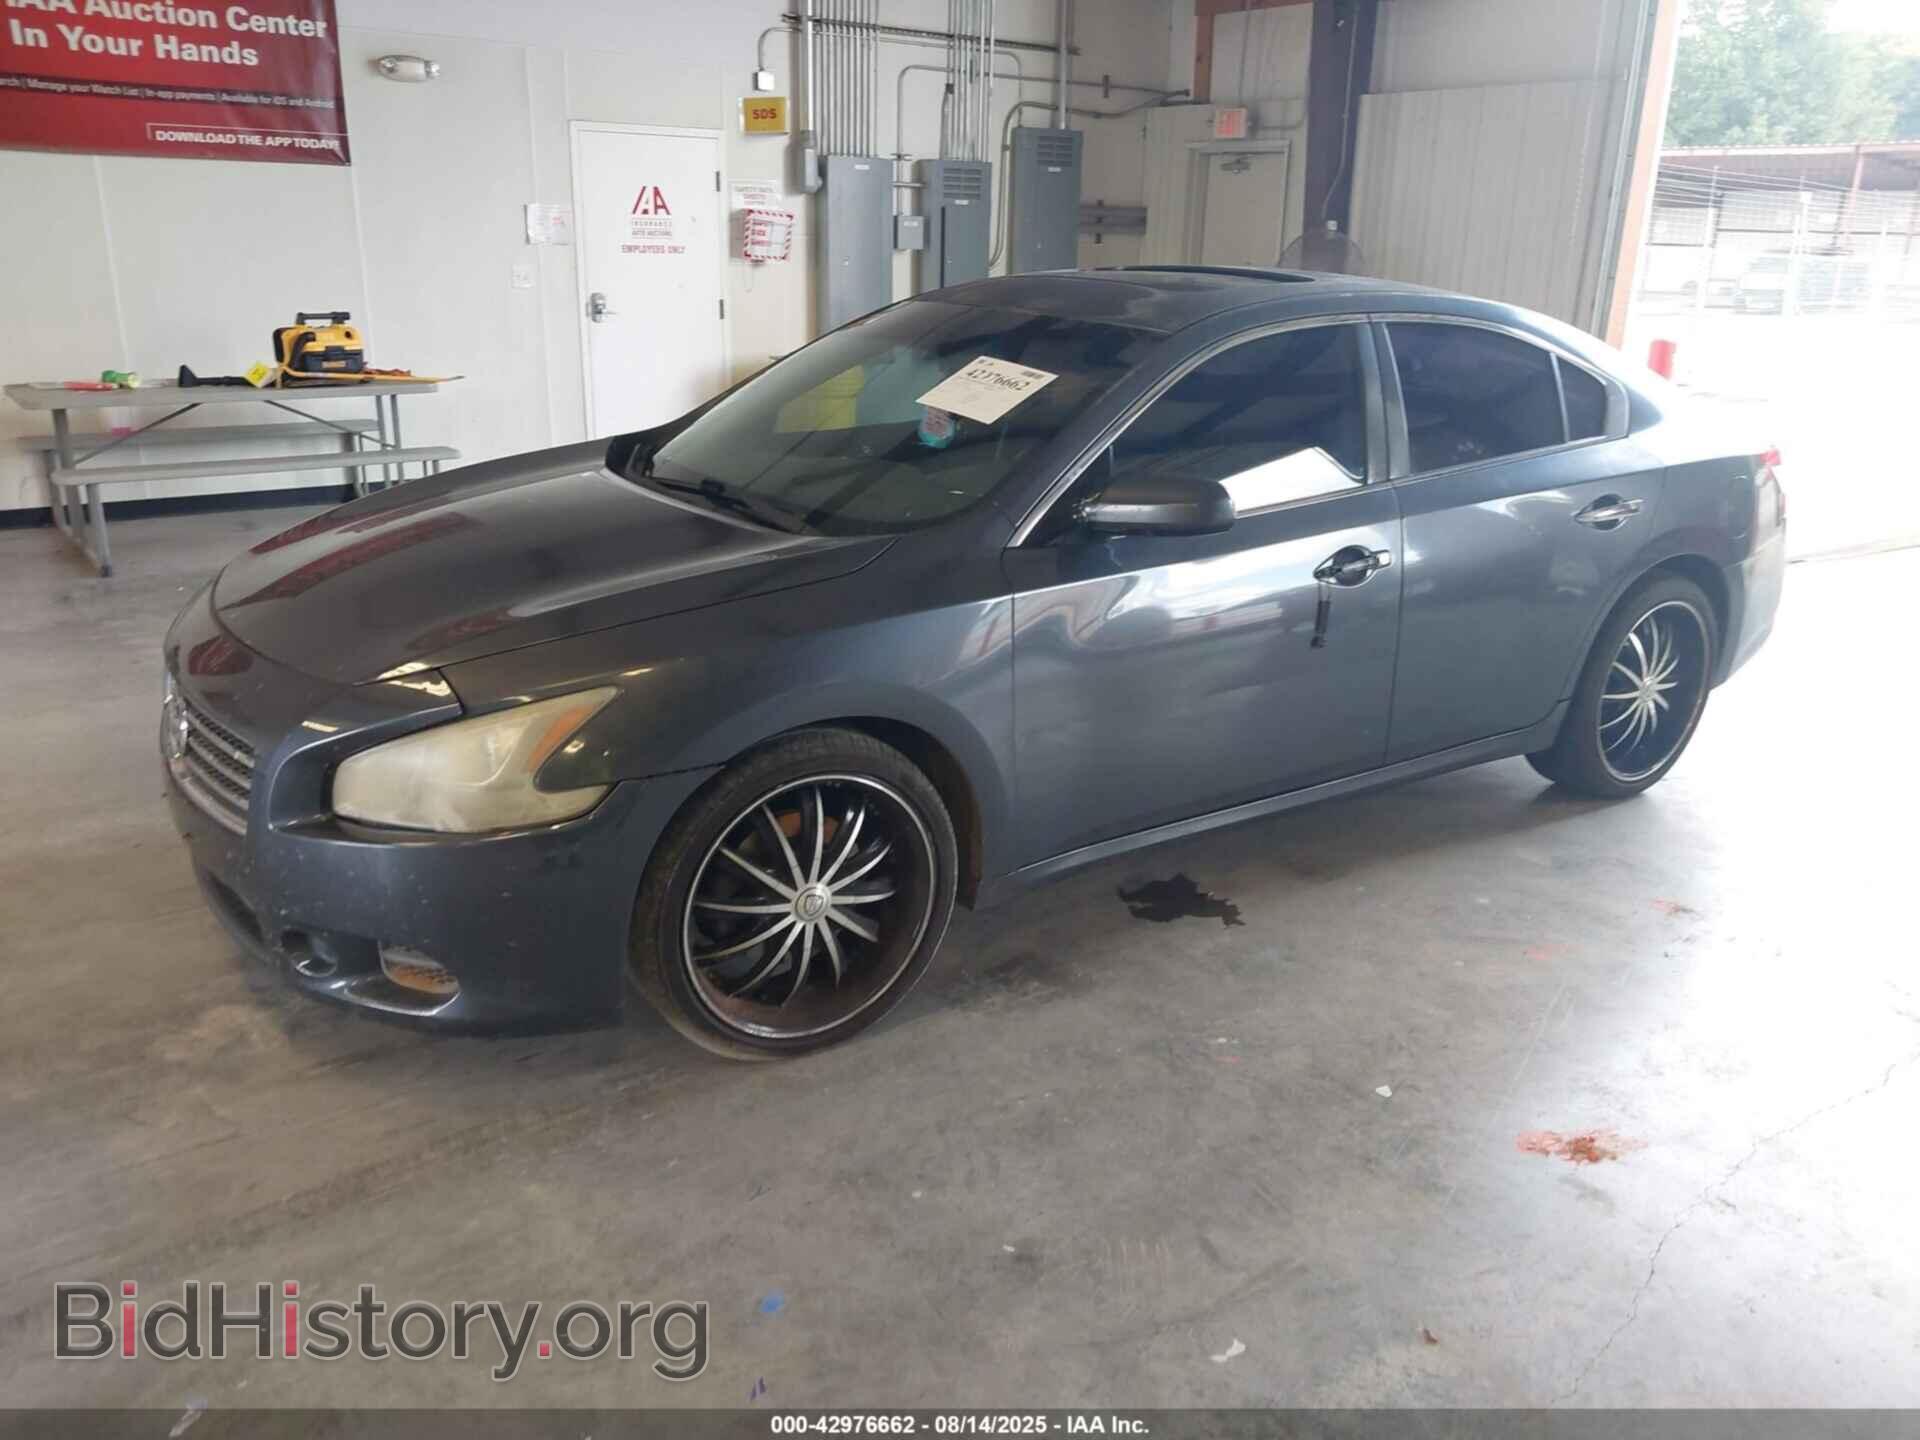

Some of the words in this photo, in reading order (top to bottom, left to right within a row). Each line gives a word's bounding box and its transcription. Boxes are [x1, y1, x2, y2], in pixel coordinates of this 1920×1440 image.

[84, 0, 217, 28] Auction
[225, 6, 327, 38] Center
[9, 18, 48, 48] In
[56, 24, 143, 57] Your
[154, 34, 259, 66] Hands
[752, 107, 777, 120] SDS
[155, 130, 237, 145] DOWNLOAD
[237, 133, 262, 146] THE
[265, 136, 291, 148] APP
[621, 244, 664, 254] EMPLOYEES
[668, 245, 686, 254] ONLY
